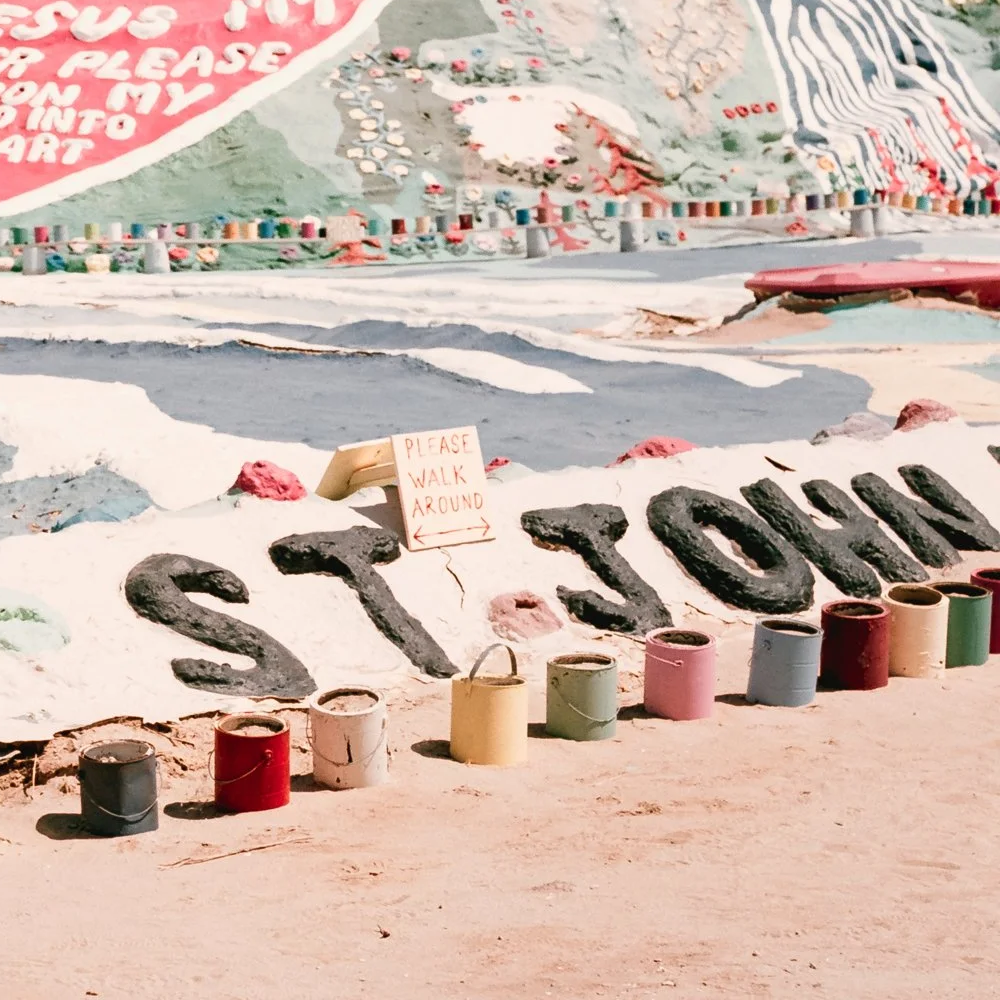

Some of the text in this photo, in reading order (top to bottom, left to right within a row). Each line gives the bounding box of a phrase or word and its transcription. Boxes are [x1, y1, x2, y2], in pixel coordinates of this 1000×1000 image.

[57, 41, 292, 81] PLEASE
[106, 82, 215, 116] MY
[27, 106, 137, 140] INTO
[405, 434, 474, 459] PLEASE
[408, 465, 468, 489] WALK
[411, 492, 484, 519] AROUND
[126, 464, 1000, 699] ST JOHN
